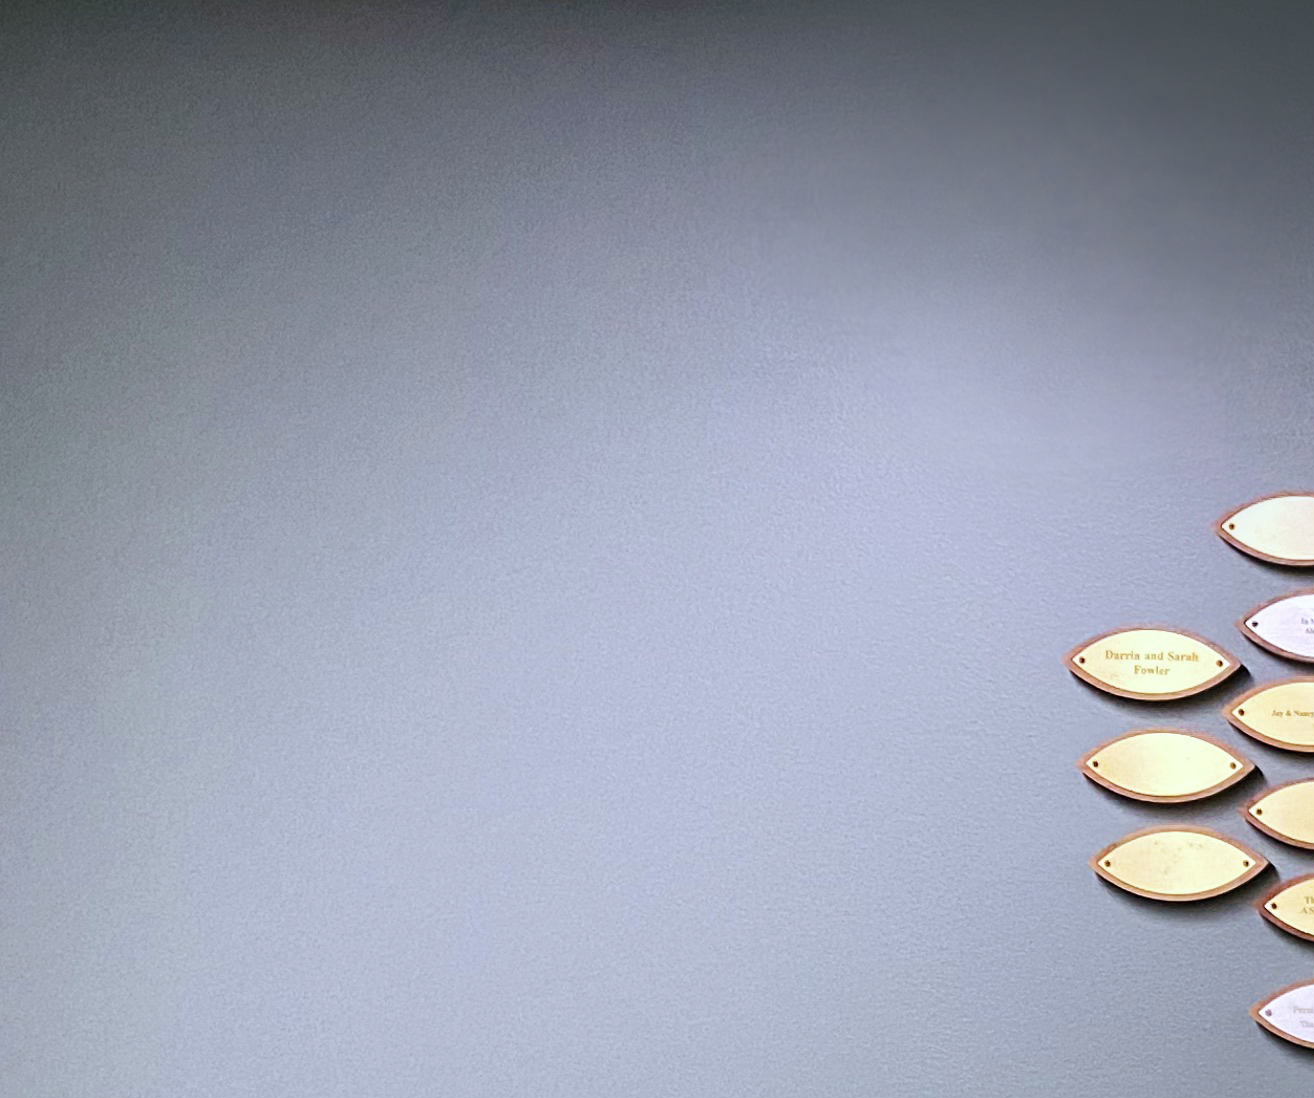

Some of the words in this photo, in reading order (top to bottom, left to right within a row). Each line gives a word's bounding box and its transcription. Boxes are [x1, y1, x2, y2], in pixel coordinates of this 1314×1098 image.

[1105, 649, 1141, 661] Darrin
[1144, 651, 1164, 661] and
[1167, 651, 1199, 662] Sarah
[1134, 664, 1171, 676] Fowler
